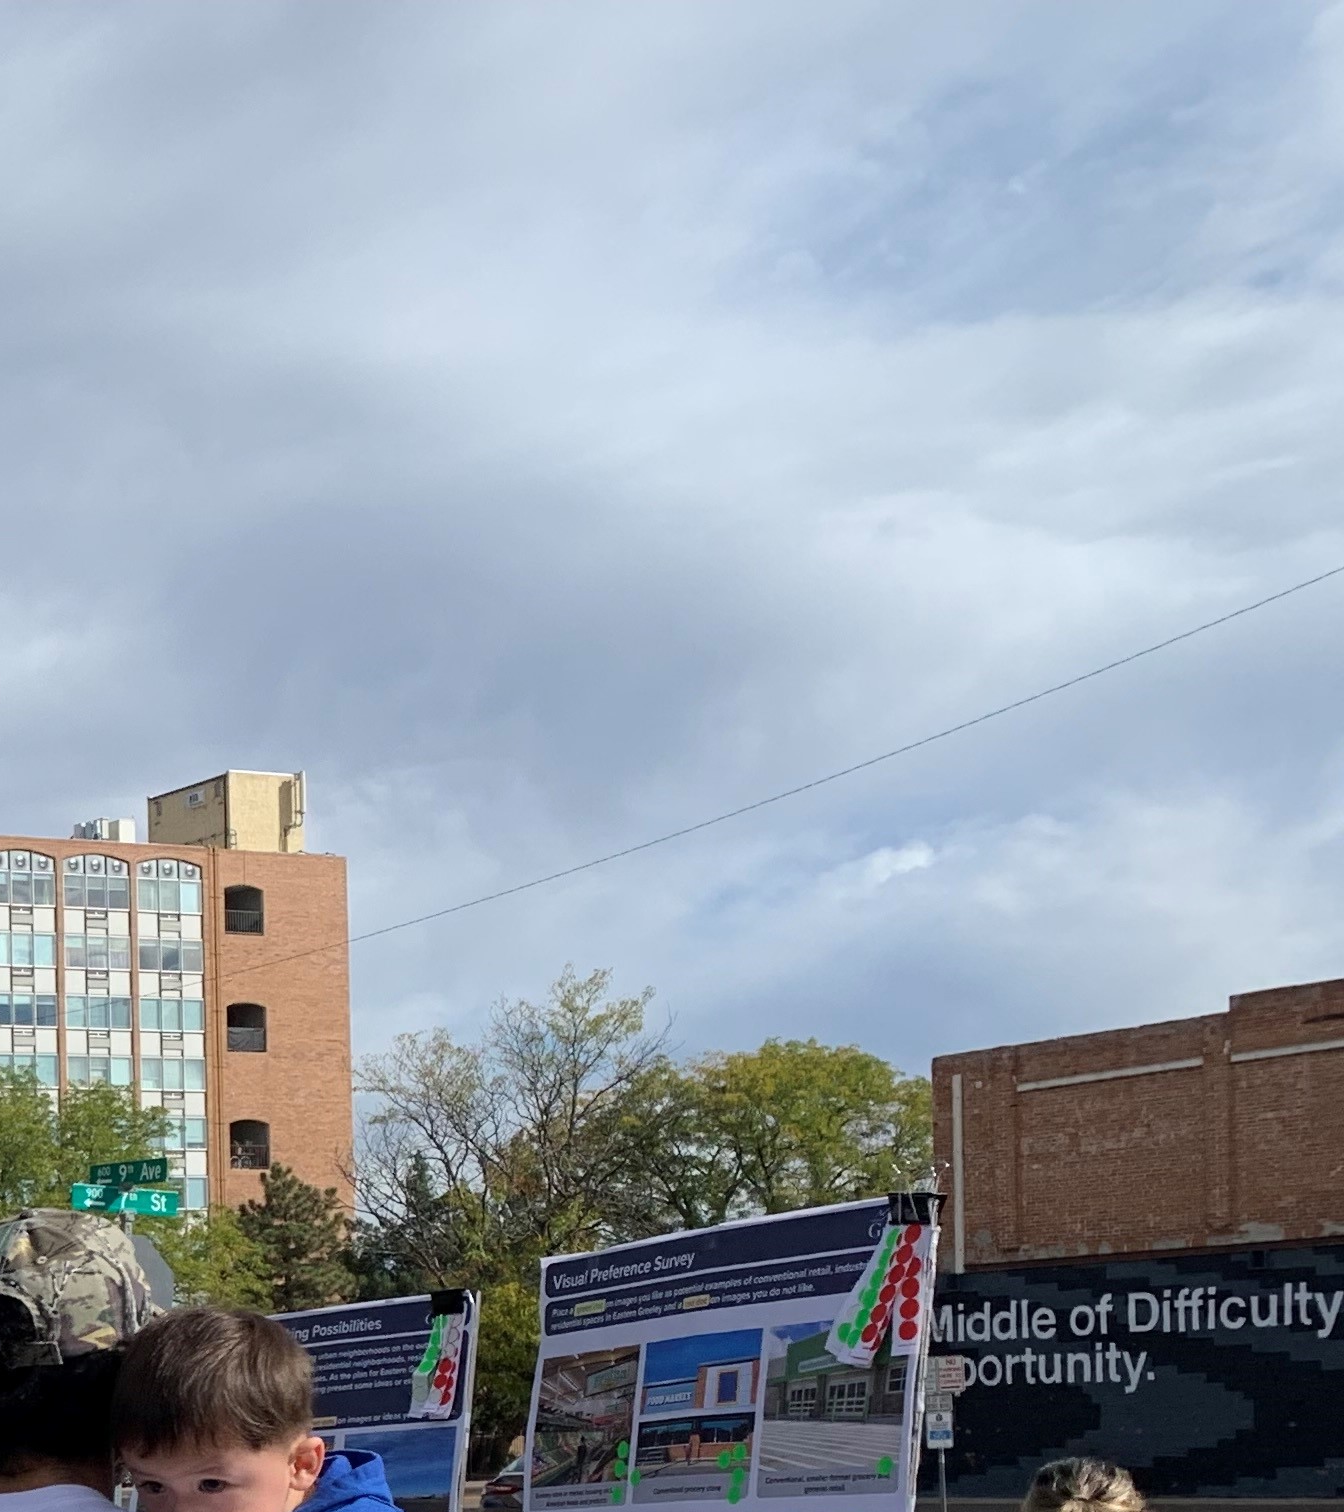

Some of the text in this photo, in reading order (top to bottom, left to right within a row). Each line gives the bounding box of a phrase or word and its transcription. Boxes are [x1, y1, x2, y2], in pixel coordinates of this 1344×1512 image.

[97, 1165, 111, 1178] 600
[139, 1162, 162, 1181] Ave
[85, 1187, 104, 1199] 900
[150, 1193, 168, 1213] St
[553, 1252, 696, 1290] Visual Preference Survey
[930, 1282, 1344, 1344] Middle of Difficulty
[312, 1318, 382, 1337] Possibilities
